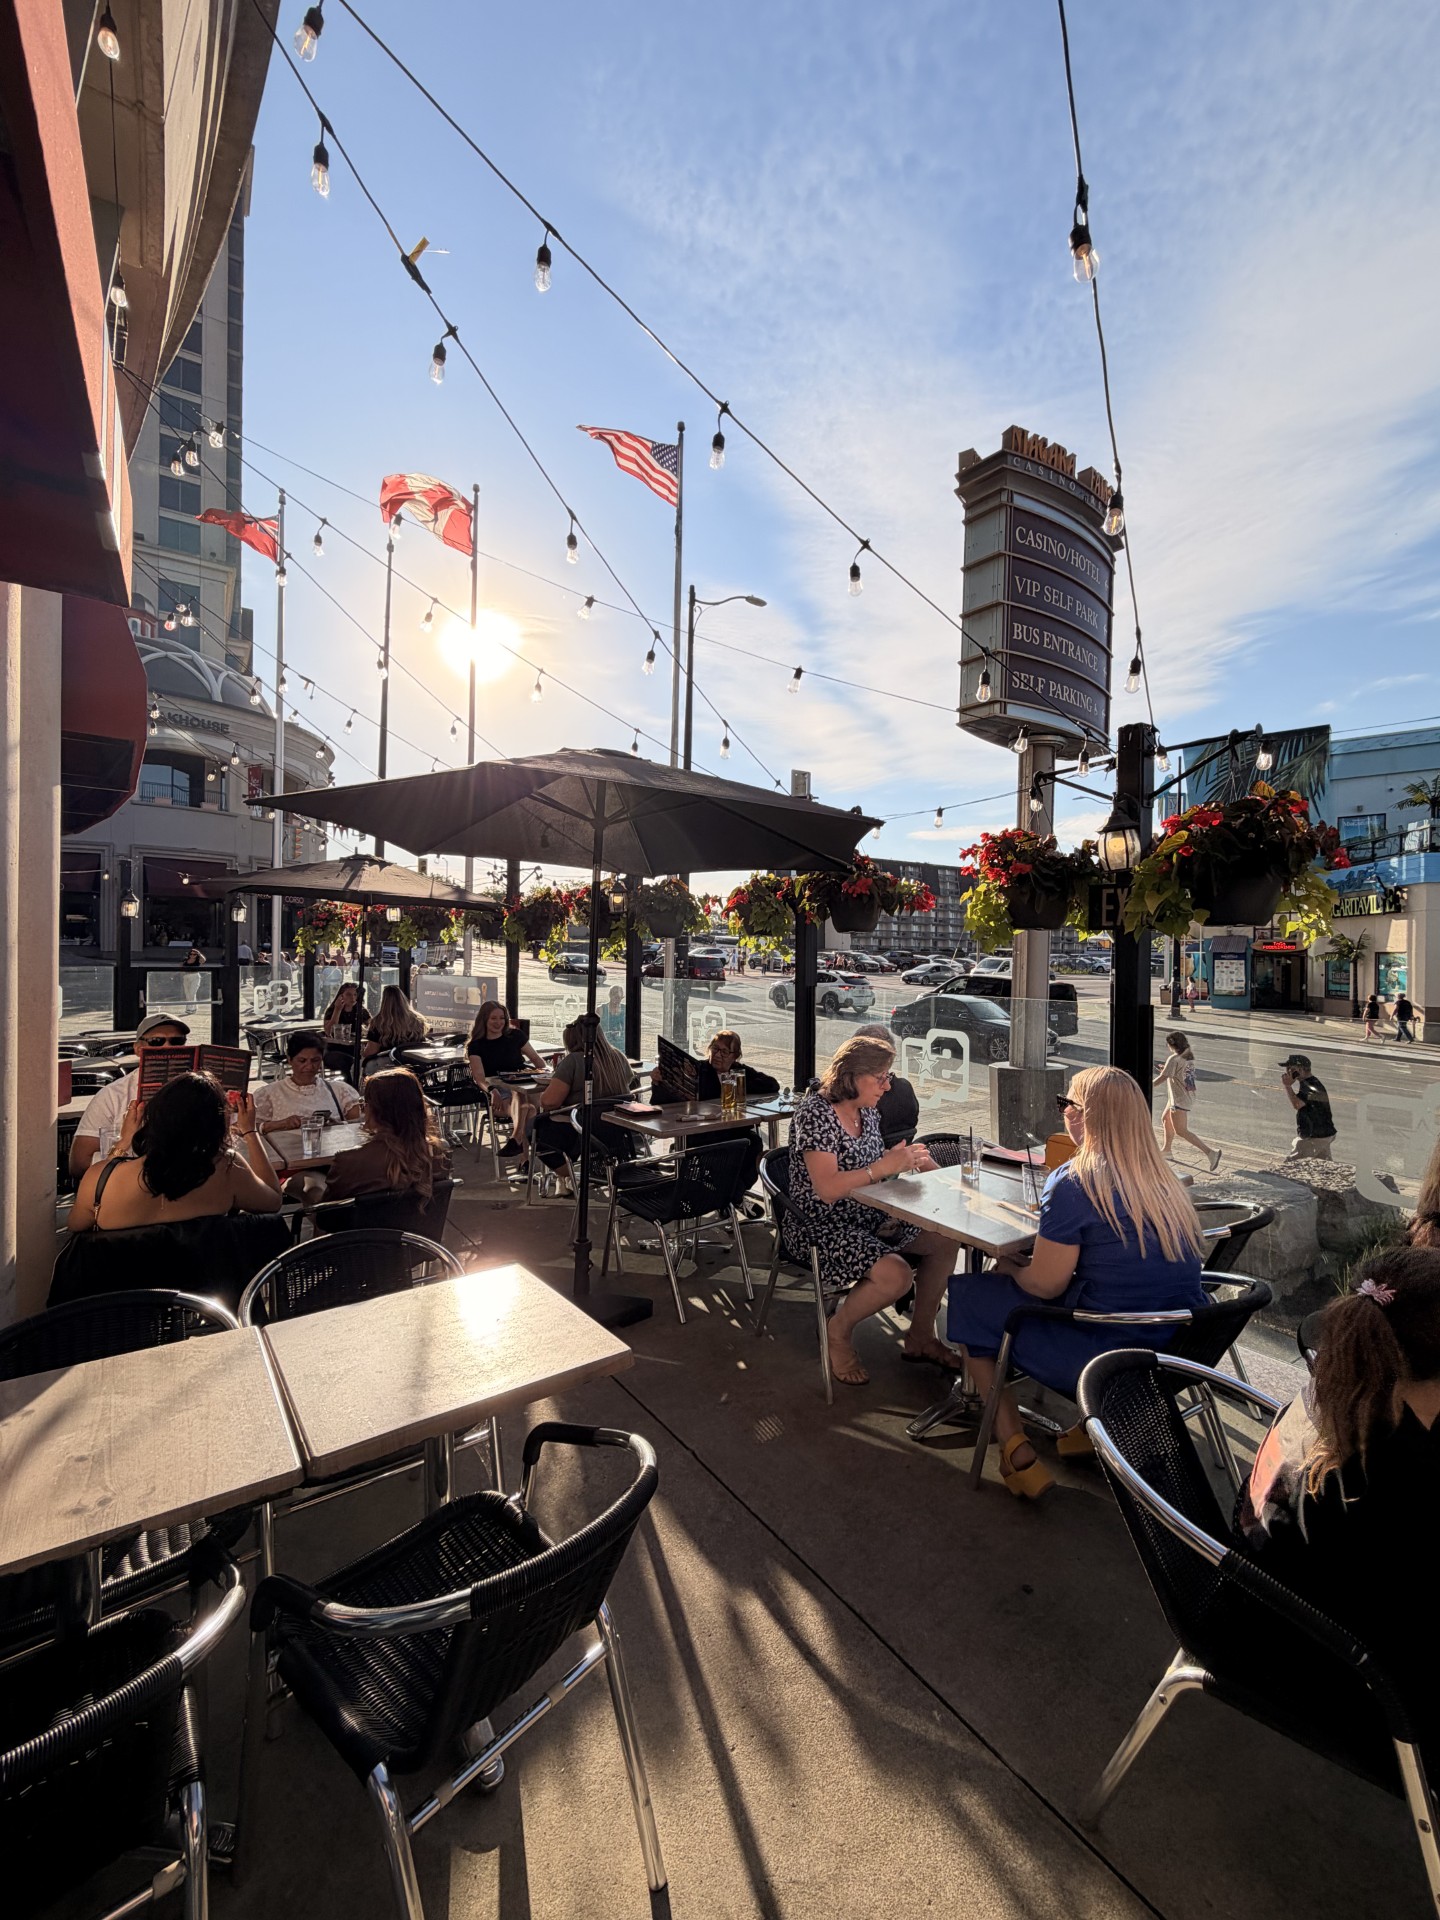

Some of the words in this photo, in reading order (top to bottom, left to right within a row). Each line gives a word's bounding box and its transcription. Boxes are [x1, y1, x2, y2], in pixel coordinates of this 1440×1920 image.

[1011, 426, 1076, 479] NIAGARA
[1013, 457, 1076, 492] CASINO
[1015, 526, 1101, 584] CASINO/HOTEL
[1014, 575, 1041, 598] VIP
[1043, 585, 1073, 611] SELF
[1075, 601, 1099, 629] PARK
[1012, 622, 1040, 645] BUS
[1043, 630, 1098, 673] ENTRANCE
[1011, 671, 1046, 697] SELF
[1049, 681, 1093, 712] PARKING
[285, 896, 304, 904] CORSO
